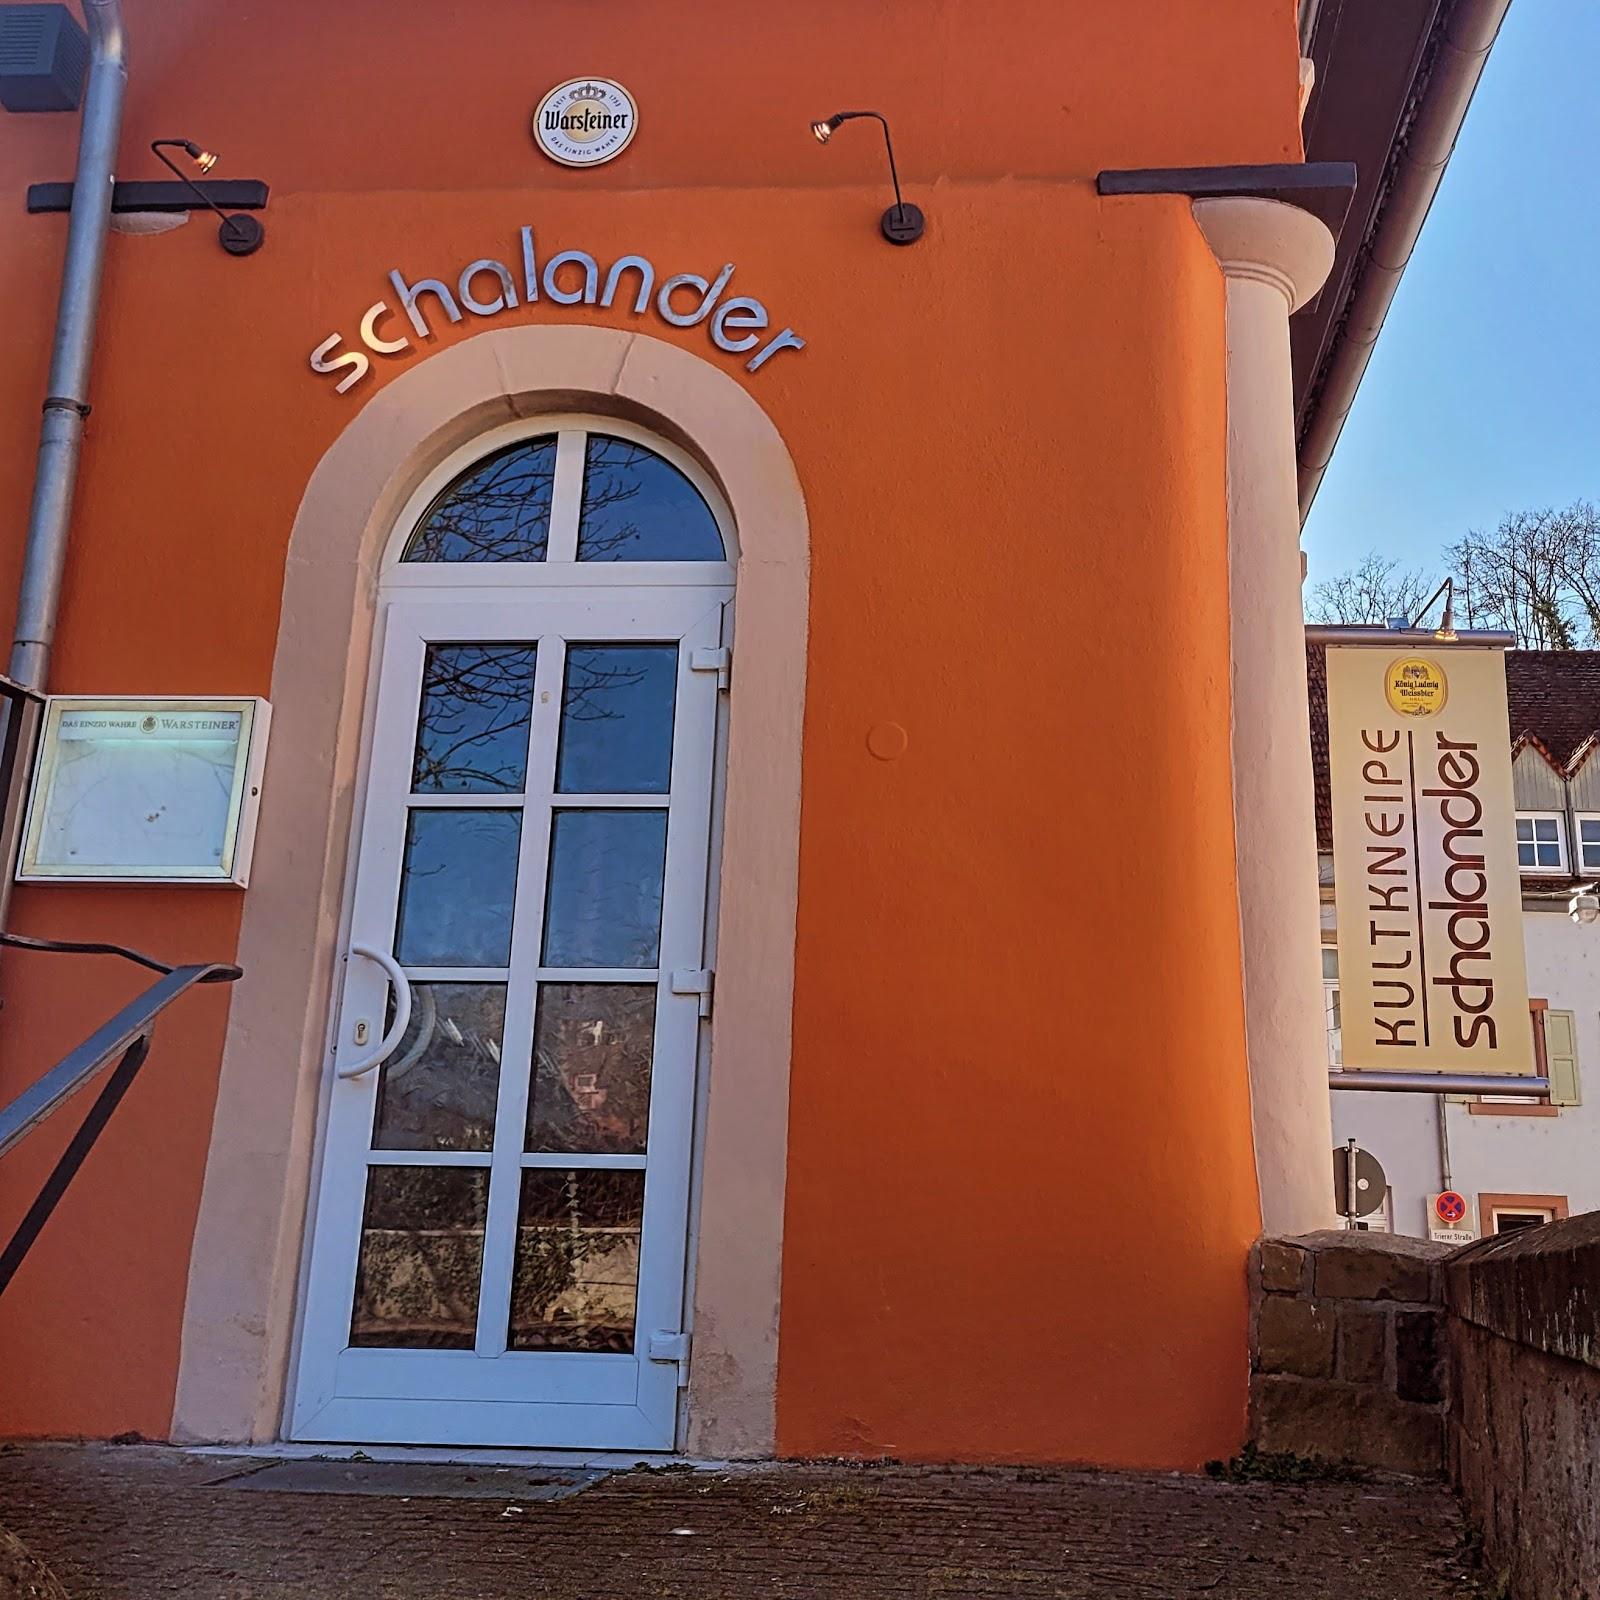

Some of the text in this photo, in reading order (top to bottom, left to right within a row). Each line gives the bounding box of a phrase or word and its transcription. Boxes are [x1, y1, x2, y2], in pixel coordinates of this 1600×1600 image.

[545, 107, 628, 132] Warsteiner
[551, 135, 618, 155] DAS EINZIG WAHRE
[309, 225, 807, 395] schalander
[1393, 680, 1439, 691] König Ludwig
[1400, 689, 1435, 697] Weissbier
[62, 719, 238, 730] DAS EINZIG WAHRE WARSTEINER
[1361, 729, 1416, 1047] KULTKNEIPE
[1422, 731, 1497, 1049] schalander
[1434, 1232, 1472, 1242] Trierer Straße
